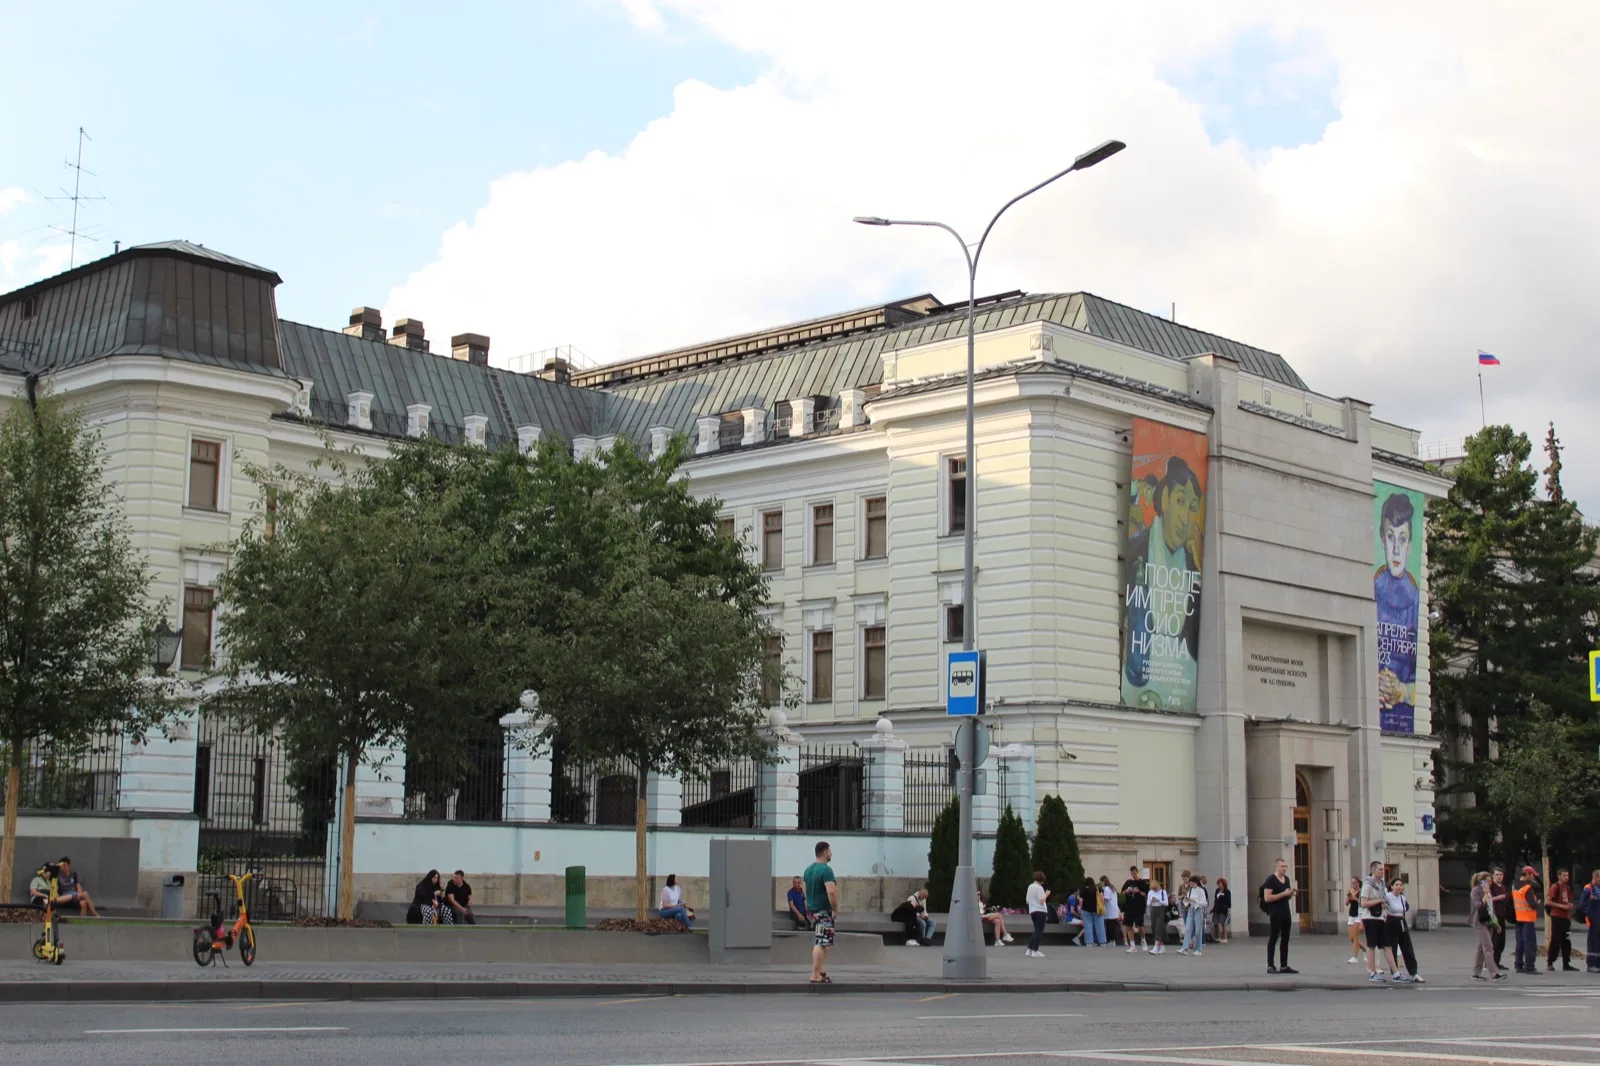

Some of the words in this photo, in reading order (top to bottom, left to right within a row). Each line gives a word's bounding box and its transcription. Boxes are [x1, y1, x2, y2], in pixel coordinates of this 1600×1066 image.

[1144, 563, 1201, 594] ПОСЛЕ
[1125, 583, 1195, 617] ИМПРЕС
[1144, 610, 1180, 636] СИО
[1131, 630, 1190, 660] НИЗМА
